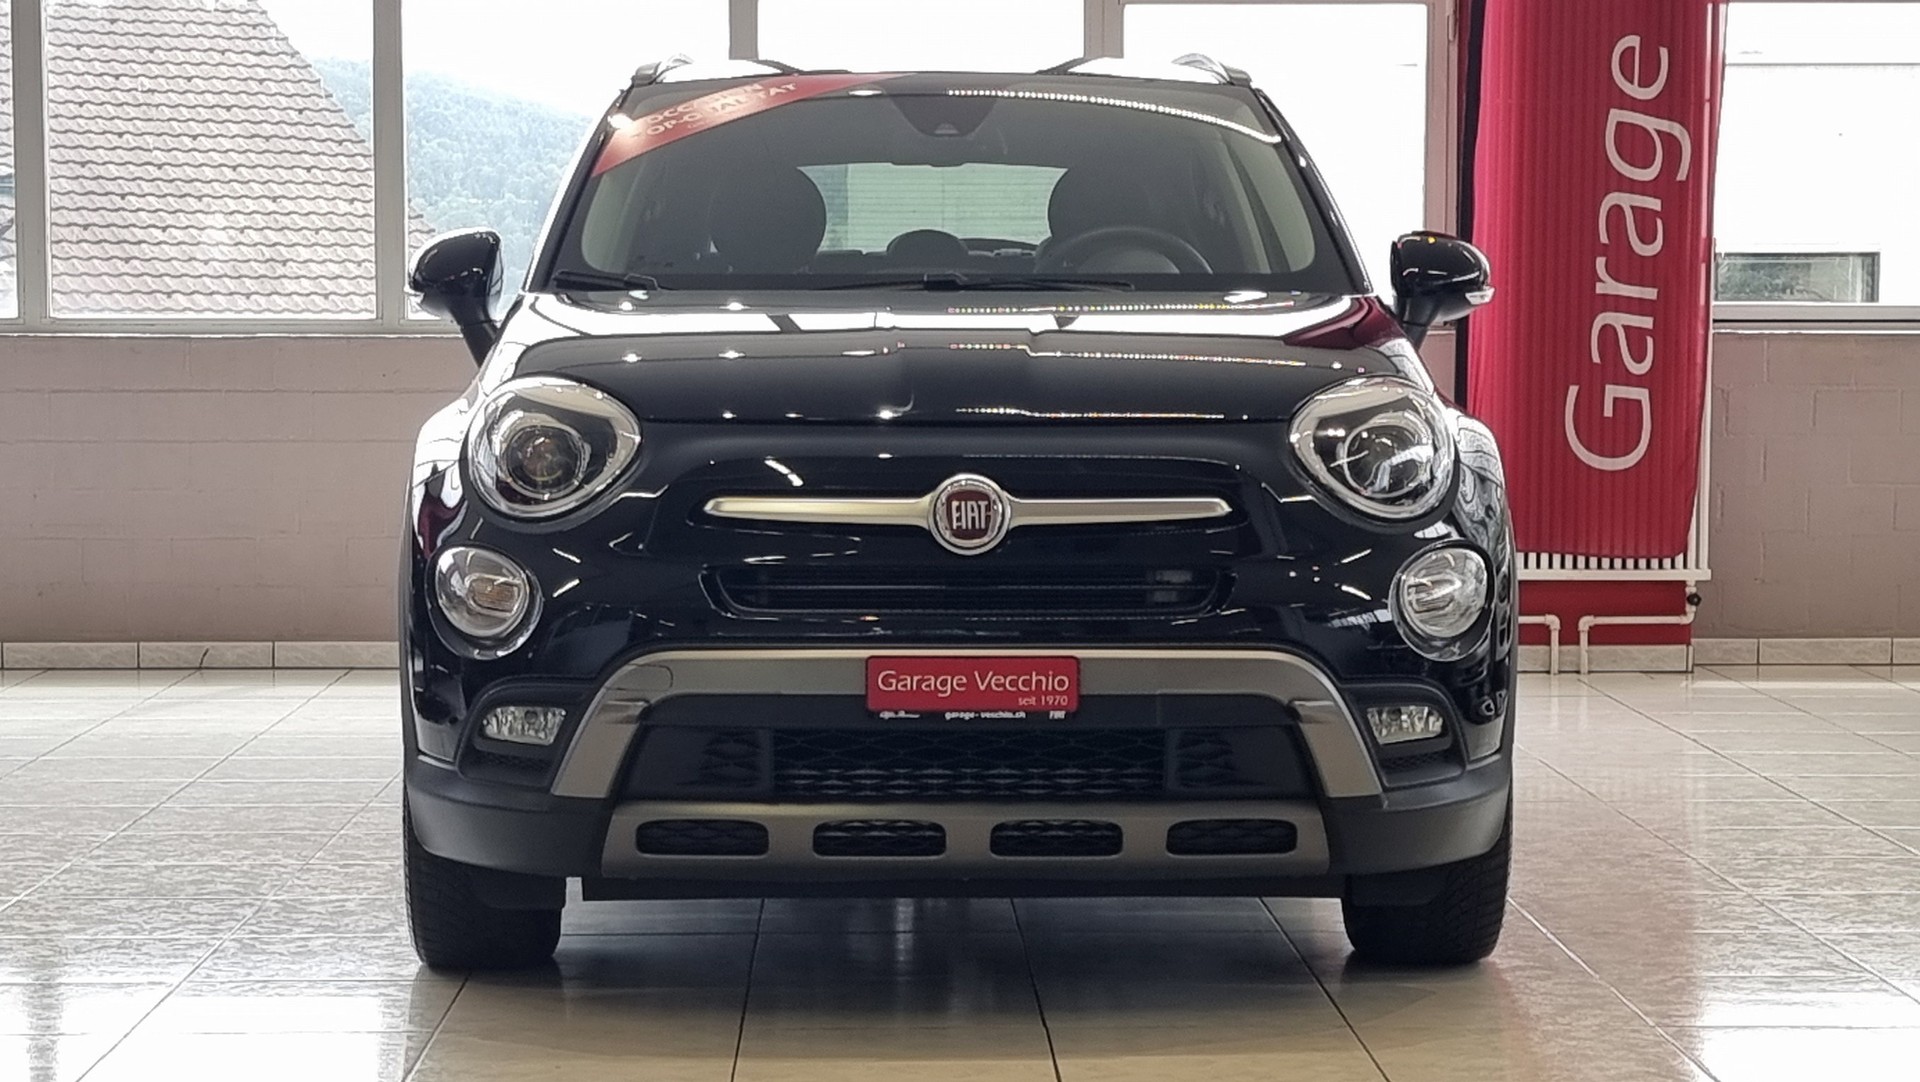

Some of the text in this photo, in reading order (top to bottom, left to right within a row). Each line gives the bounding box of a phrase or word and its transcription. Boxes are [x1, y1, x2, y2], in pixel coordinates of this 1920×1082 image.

[1565, 34, 1691, 471] Garage
[951, 500, 988, 530] FIAT
[877, 670, 1069, 698] Garage Vecchio
[1018, 695, 1068, 706] seit 1970
